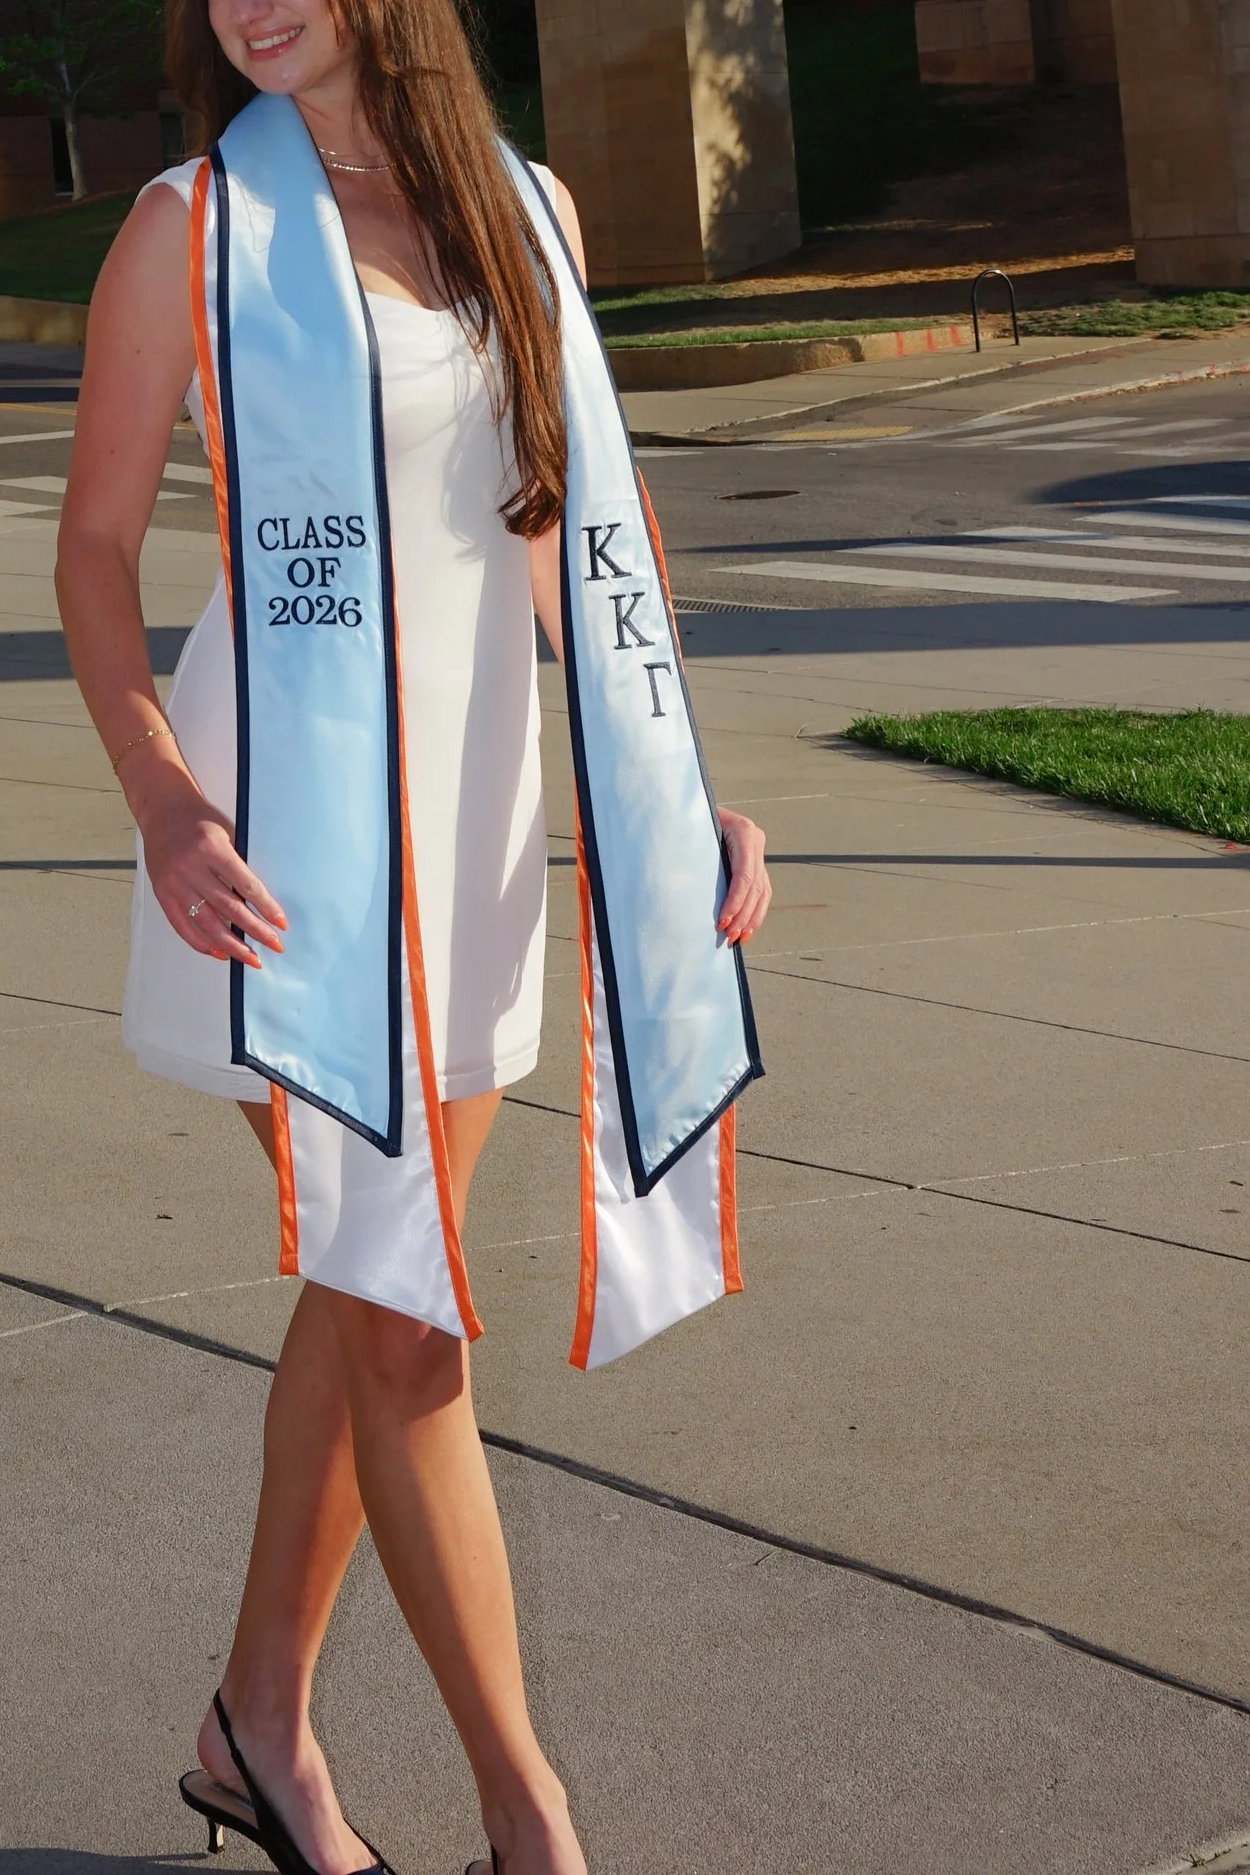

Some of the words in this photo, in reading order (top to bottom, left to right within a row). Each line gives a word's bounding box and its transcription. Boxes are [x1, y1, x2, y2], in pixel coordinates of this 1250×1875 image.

[257, 515, 366, 551] CLASS
[287, 557, 341, 588] OF
[268, 594, 362, 627] 2026
